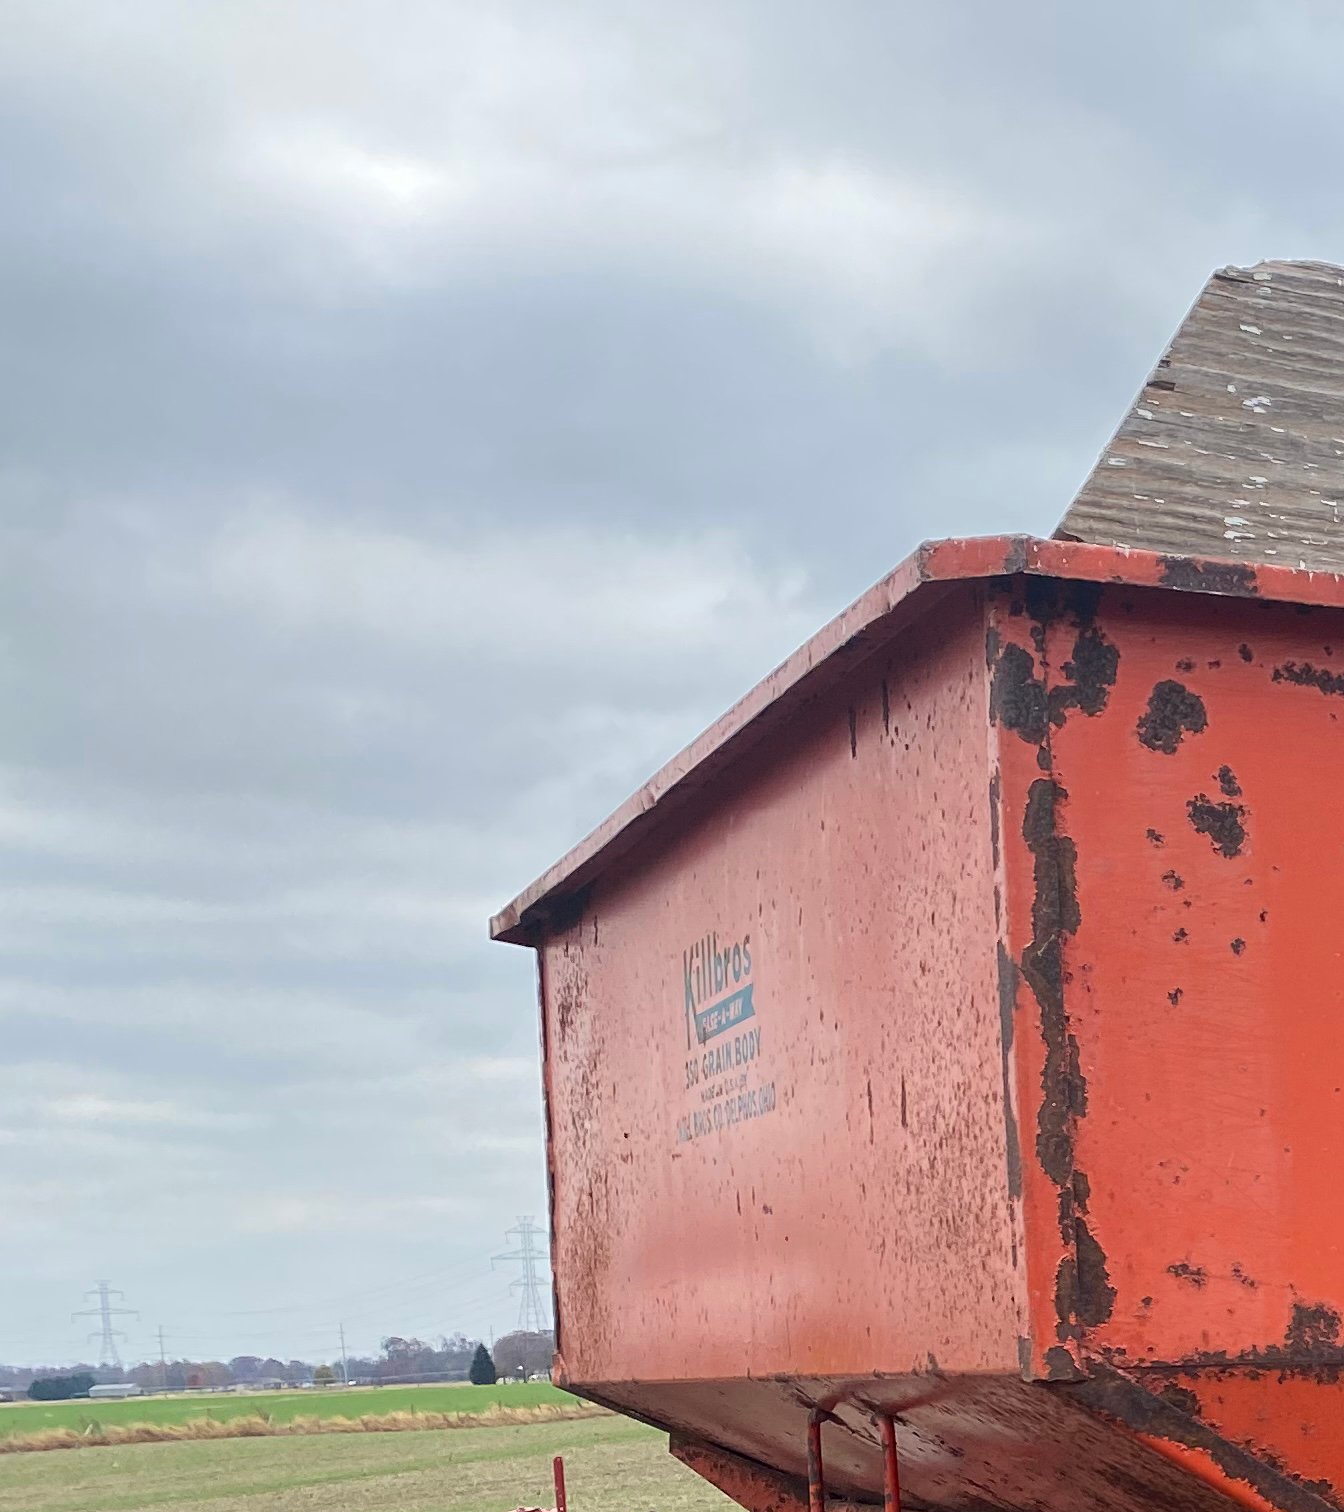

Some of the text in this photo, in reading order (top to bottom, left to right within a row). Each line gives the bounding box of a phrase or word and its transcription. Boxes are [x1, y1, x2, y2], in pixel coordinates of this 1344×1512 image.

[683, 931, 752, 1051] Killbros
[702, 1040, 733, 1080] GRAIN
[735, 1024, 761, 1066] BODY
